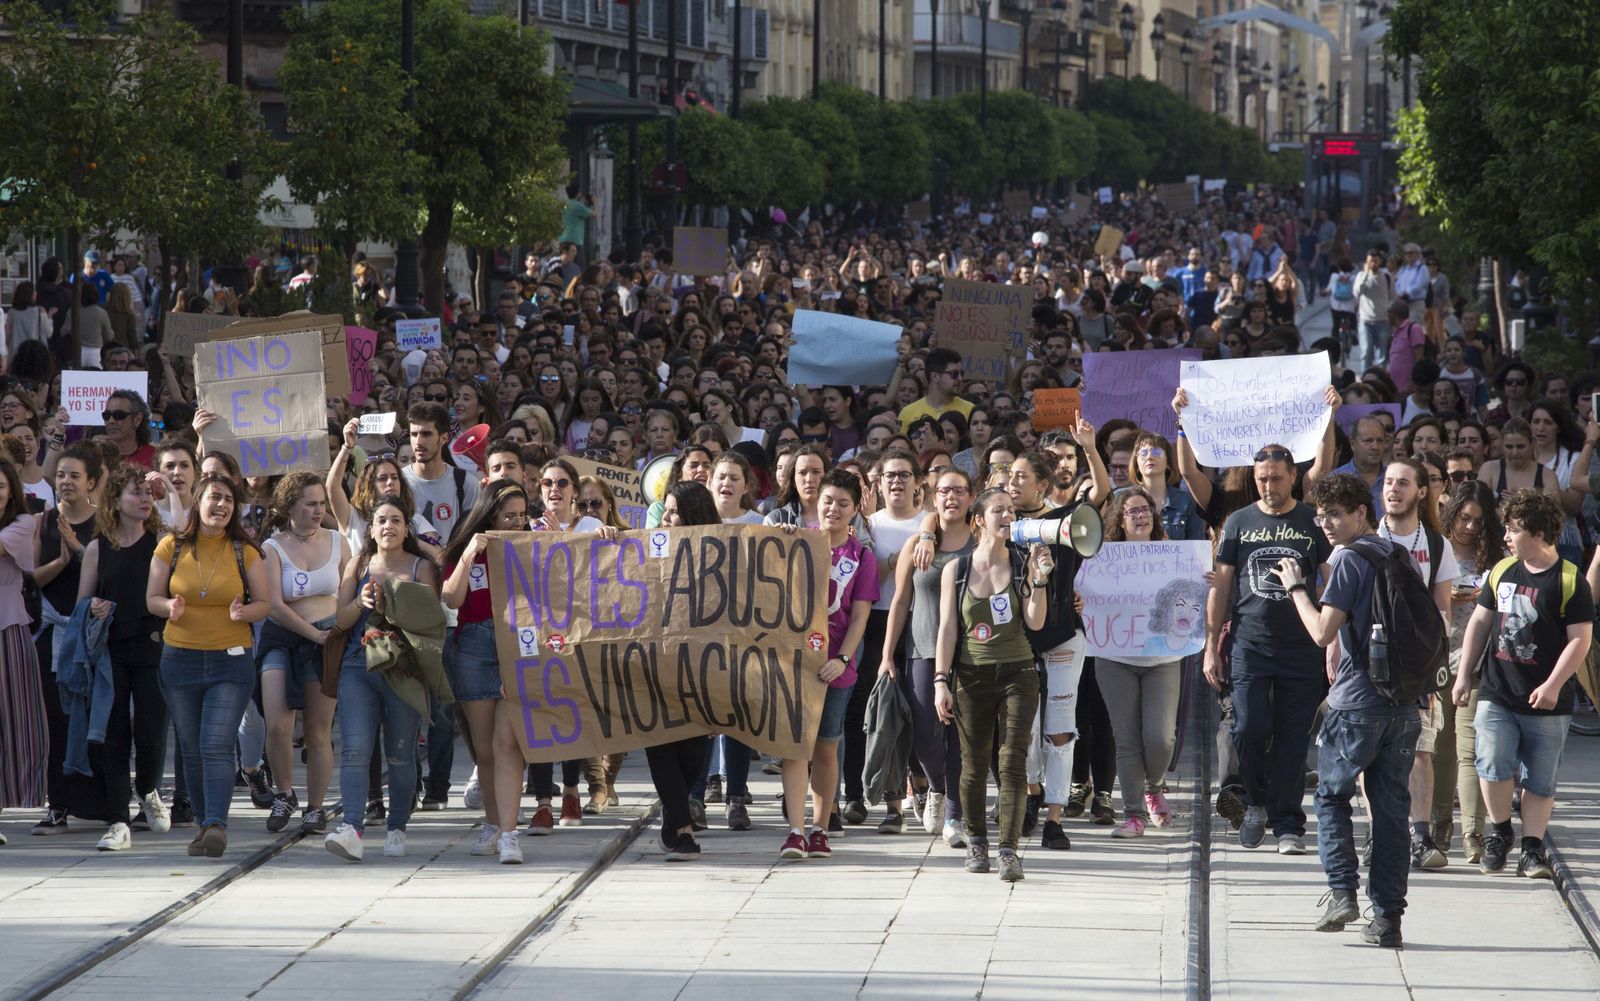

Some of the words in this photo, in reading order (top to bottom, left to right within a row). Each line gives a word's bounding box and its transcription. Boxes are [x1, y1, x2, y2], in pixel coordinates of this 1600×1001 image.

[951, 287, 1022, 310] NINGUNA
[940, 305, 962, 322] NO
[967, 307, 990, 325] ES
[402, 336, 435, 346] MANADA
[946, 323, 998, 341] ABUSO
[215, 338, 292, 379] ¡NO
[68, 400, 82, 411] YO
[85, 398, 96, 411] SÍ
[231, 386, 284, 428] ES
[1260, 400, 1303, 417] TEMEN
[1305, 401, 1325, 417] QUE
[1197, 429, 1214, 445] LOS
[1216, 423, 1261, 440] HOMBRES
[1263, 421, 1278, 436] LAS
[239, 433, 310, 475] NO!
[596, 466, 632, 485] FRENTE
[1240, 527, 1273, 545] Keith
[1140, 544, 1184, 557] PATRIARCAL
[1106, 561, 1139, 586] que
[1142, 560, 1168, 575] nos
[503, 538, 574, 633] NO
[589, 537, 649, 629] ES
[661, 535, 815, 633] ABUSO
[514, 656, 583, 749] ES
[574, 631, 802, 744] VIOLACIÓN
